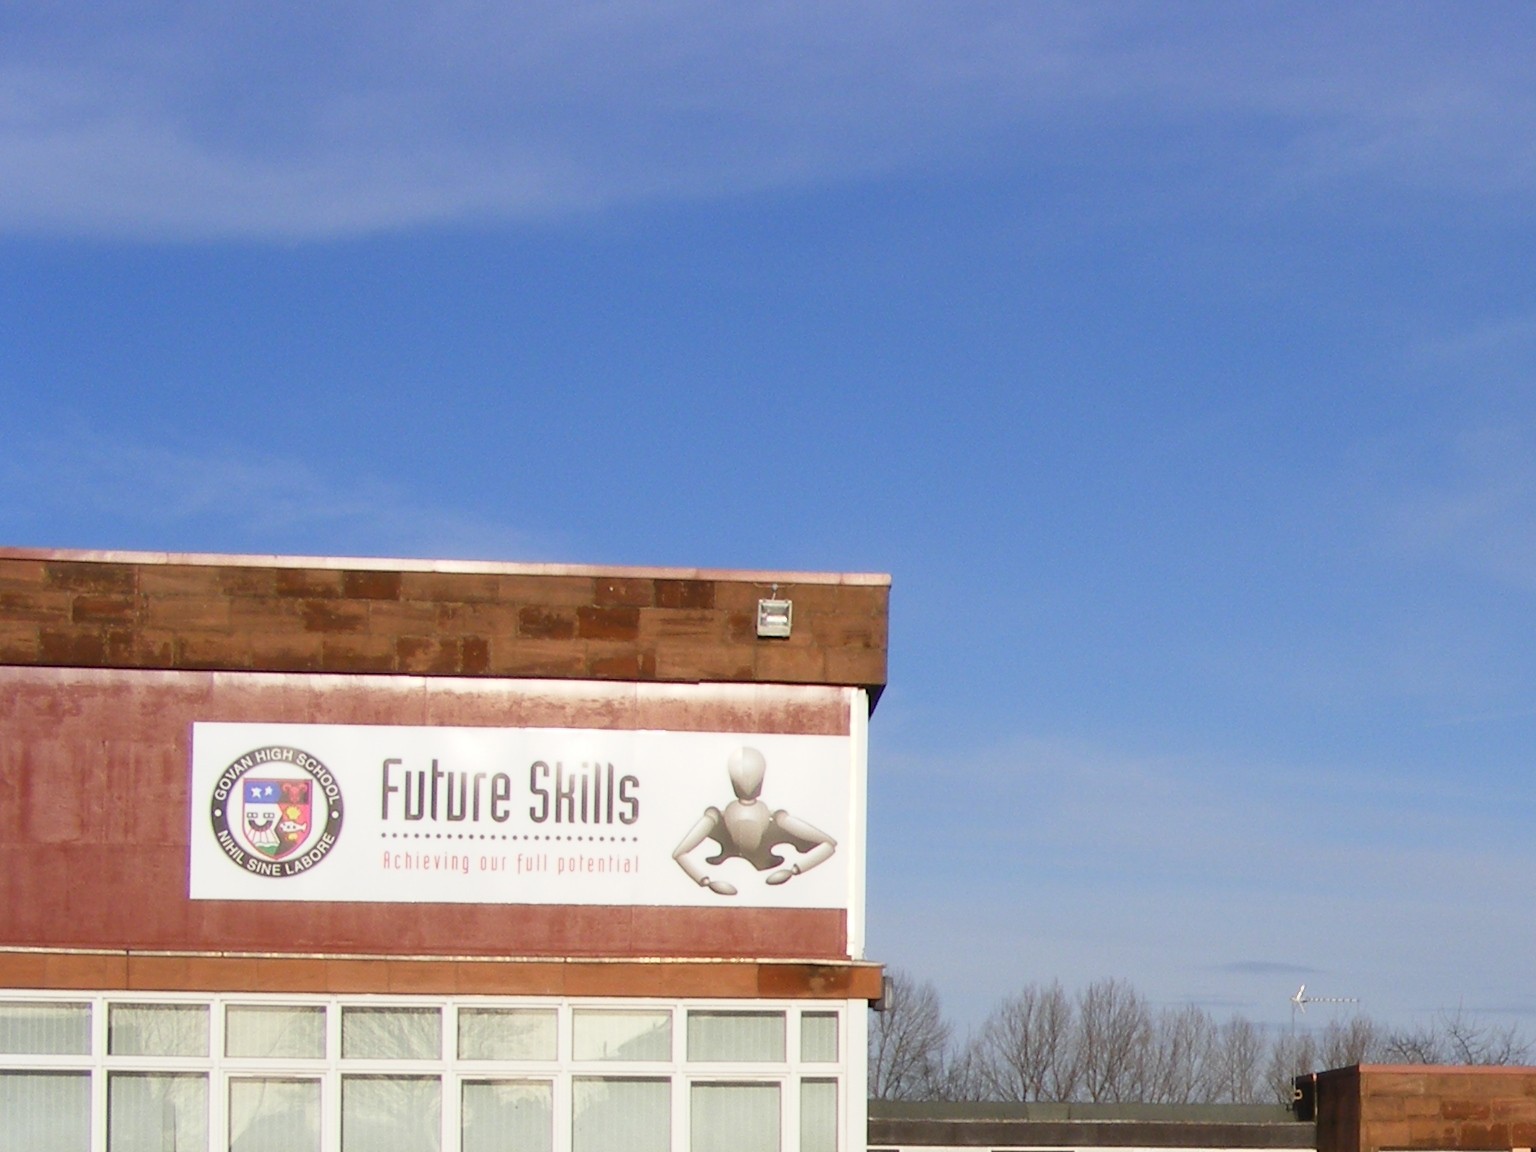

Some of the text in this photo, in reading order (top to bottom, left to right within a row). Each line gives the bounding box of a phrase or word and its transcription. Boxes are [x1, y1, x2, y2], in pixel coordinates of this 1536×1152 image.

[214, 748, 340, 805] GOVAN HIGH SCHOOL
[382, 758, 640, 825] Future Skills
[218, 830, 336, 876] NIHIL SINE LABORE
[383, 851, 639, 875] Achieving our full potential
